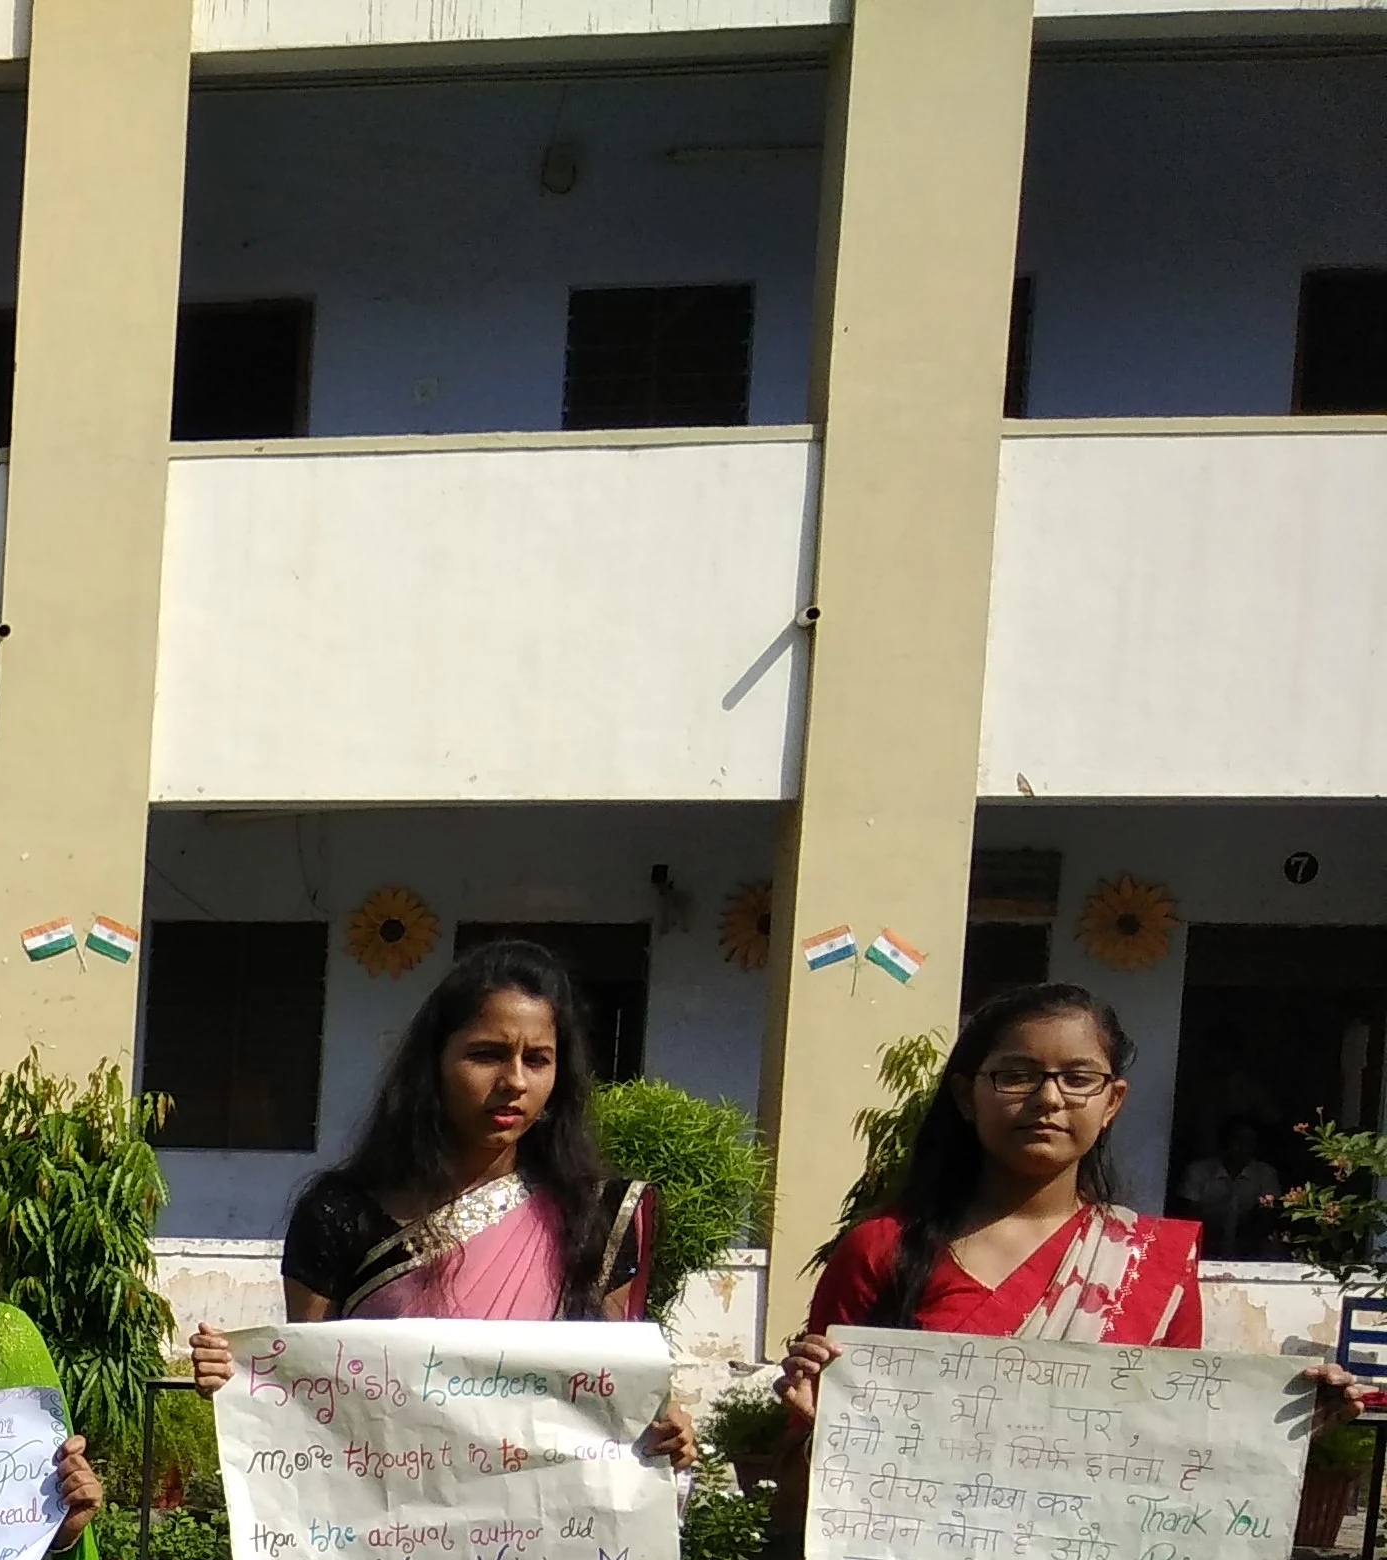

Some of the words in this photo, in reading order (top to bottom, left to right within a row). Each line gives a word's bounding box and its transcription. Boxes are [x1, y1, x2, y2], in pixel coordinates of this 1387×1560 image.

[1290, 856, 1309, 882] 7
[249, 1338, 408, 1425] English
[938, 1341, 979, 1382] भी
[984, 1345, 1092, 1388] सिखाता
[1150, 1355, 1232, 1411] और
[949, 1384, 1004, 1430] भी
[247, 1443, 334, 1480] more
[1083, 1452, 1165, 1484] इतना
[813, 1453, 862, 1495] कि
[869, 1461, 944, 1509] टीचर
[953, 1472, 1028, 1513] सीखा
[1036, 1491, 1092, 1521] कर
[249, 1522, 298, 1557] than
[308, 1517, 357, 1553] the
[367, 1520, 455, 1554] actual
[469, 1519, 545, 1553] author
[559, 1515, 595, 1542] did
[937, 1509, 1005, 1551] लेता
[1126, 1493, 1214, 1536] Thank
[1225, 1498, 1274, 1539] You
